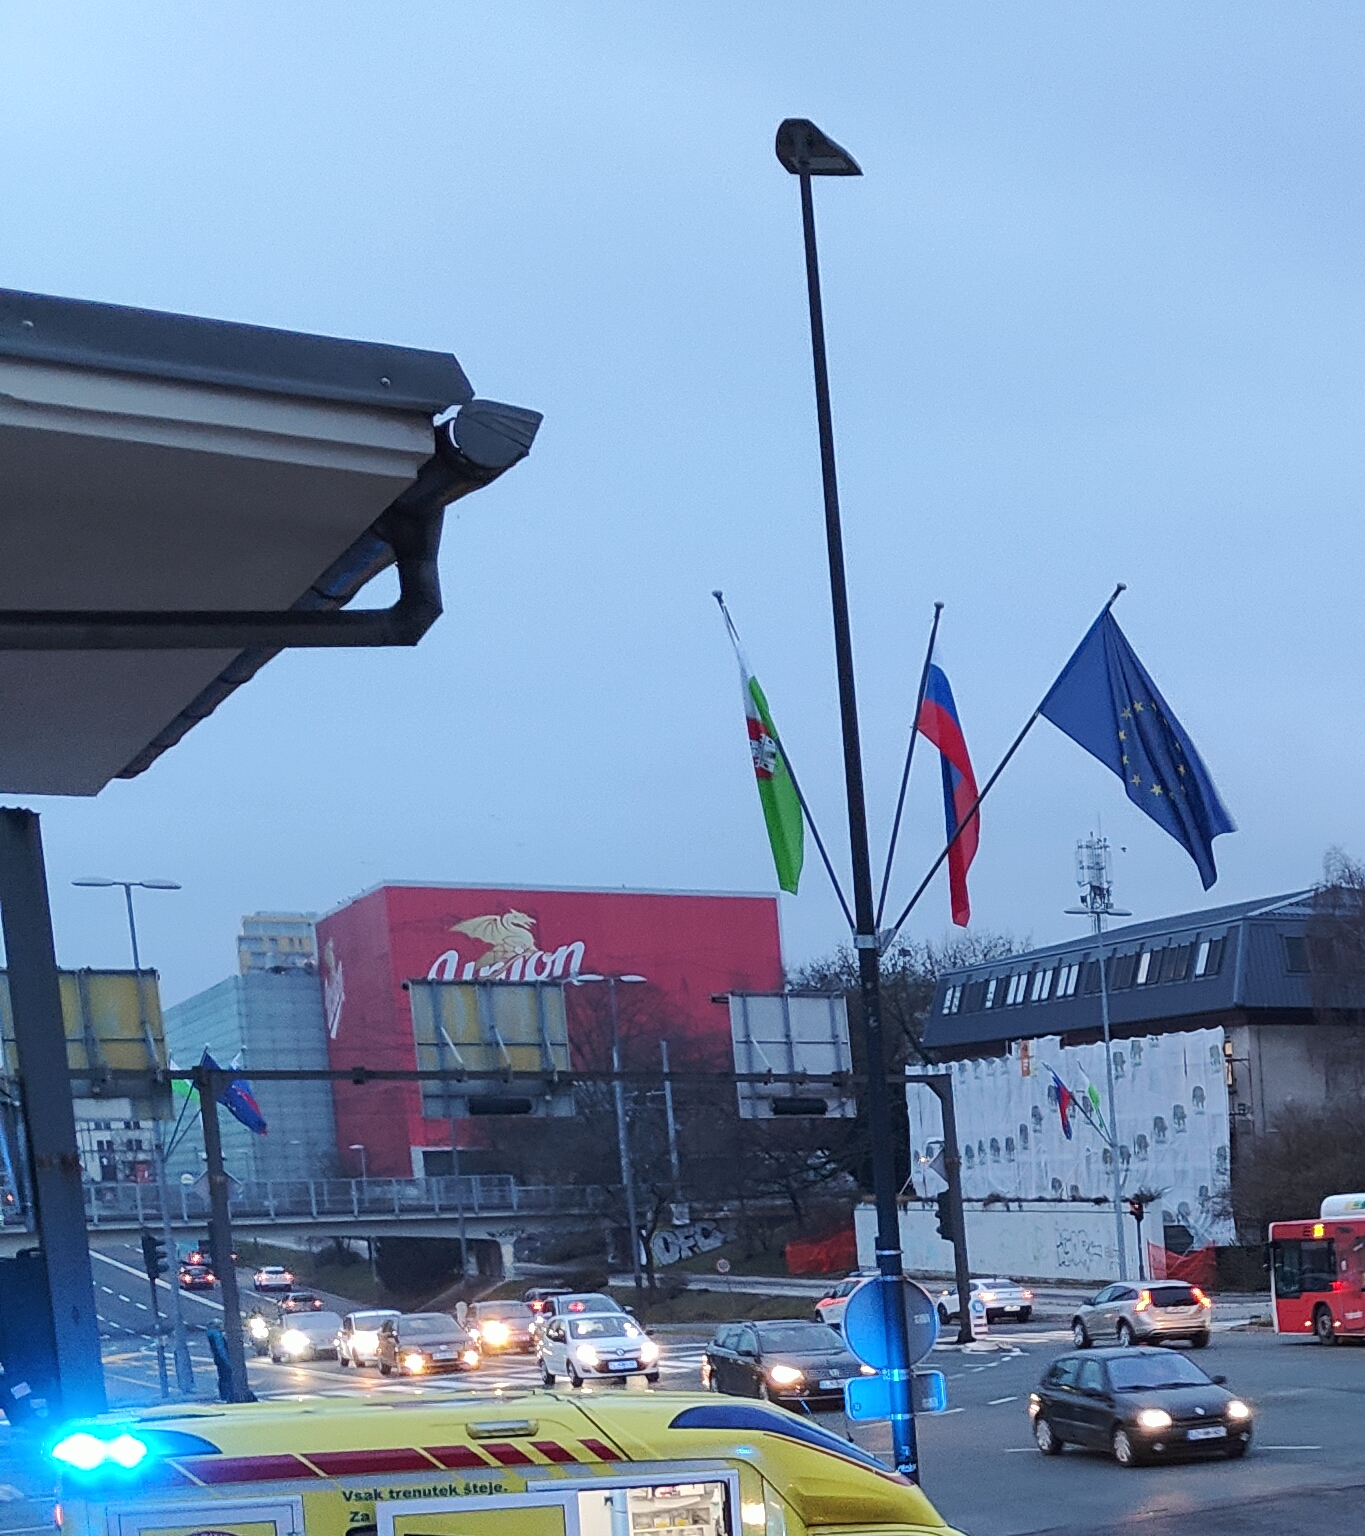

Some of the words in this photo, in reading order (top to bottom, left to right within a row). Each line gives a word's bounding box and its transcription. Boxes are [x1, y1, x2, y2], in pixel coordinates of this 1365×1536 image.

[343, 1488, 383, 1502] Vsak
[388, 1482, 458, 1500] trenutek
[463, 1481, 508, 1497] šteje.
